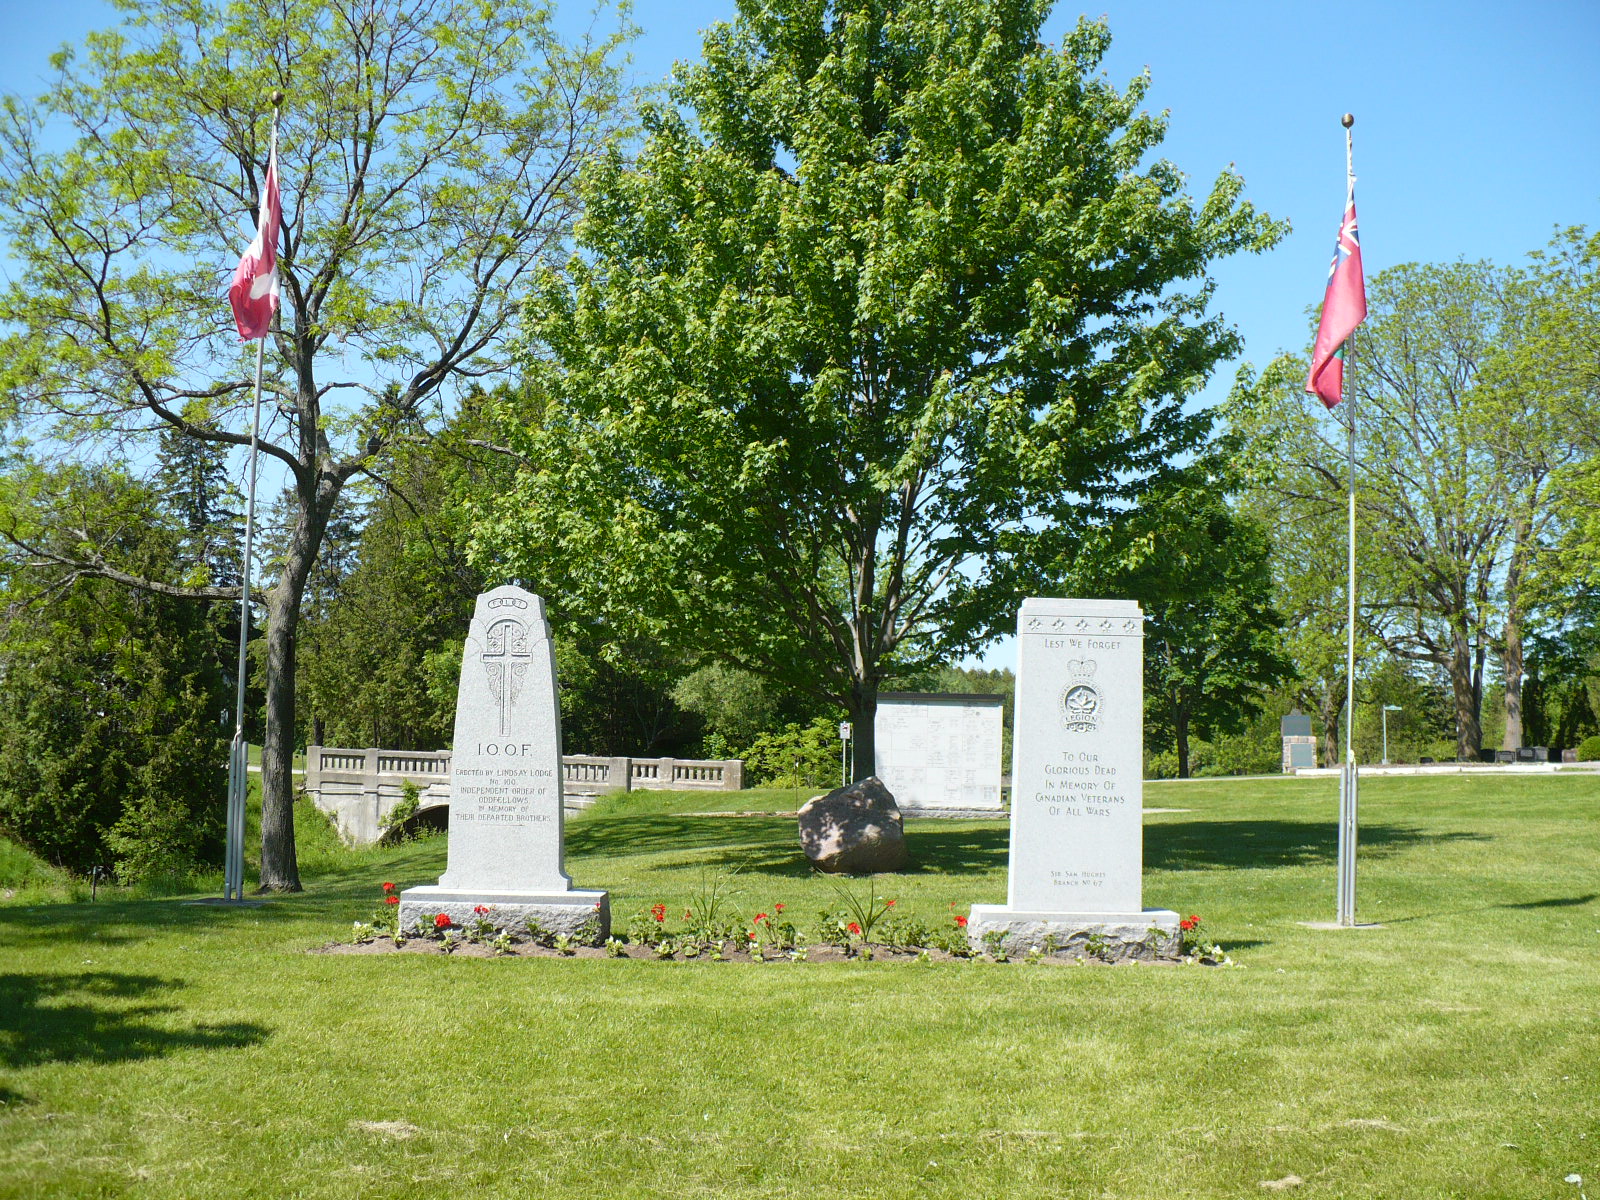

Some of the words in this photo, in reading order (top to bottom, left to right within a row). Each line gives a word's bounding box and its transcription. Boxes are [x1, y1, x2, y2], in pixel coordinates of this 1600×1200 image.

[1045, 639, 1065, 648] LEST
[1069, 639, 1082, 649] WE
[1088, 639, 1121, 650] FORGET
[1065, 714, 1097, 723] LEGION
[478, 743, 533, 757] I.O.O.F.
[1062, 751, 1074, 761] TO
[1079, 752, 1098, 762] OUR
[497, 769, 528, 777] LINDSAY
[1044, 764, 1090, 775] GLORIOUS
[1095, 765, 1117, 776] DEAD
[1045, 779, 1055, 789] IN
[1060, 780, 1099, 790] MEMORY
[1103, 781, 1116, 790] OF
[460, 787, 509, 795] INDEPENDENT
[512, 787, 535, 795] ORDER
[478, 796, 529, 804] ODDFELLOWS
[1035, 792, 1077, 803] CANADIAN
[1081, 793, 1125, 804] VETERANS
[488, 805, 517, 813] MEMORY
[520, 805, 529, 813] OF
[1049, 806, 1061, 816] OF
[1066, 806, 1082, 817] ALL
[1086, 806, 1111, 817] WARS
[455, 813, 475, 821] THEIR
[478, 813, 514, 822] DEPARTED
